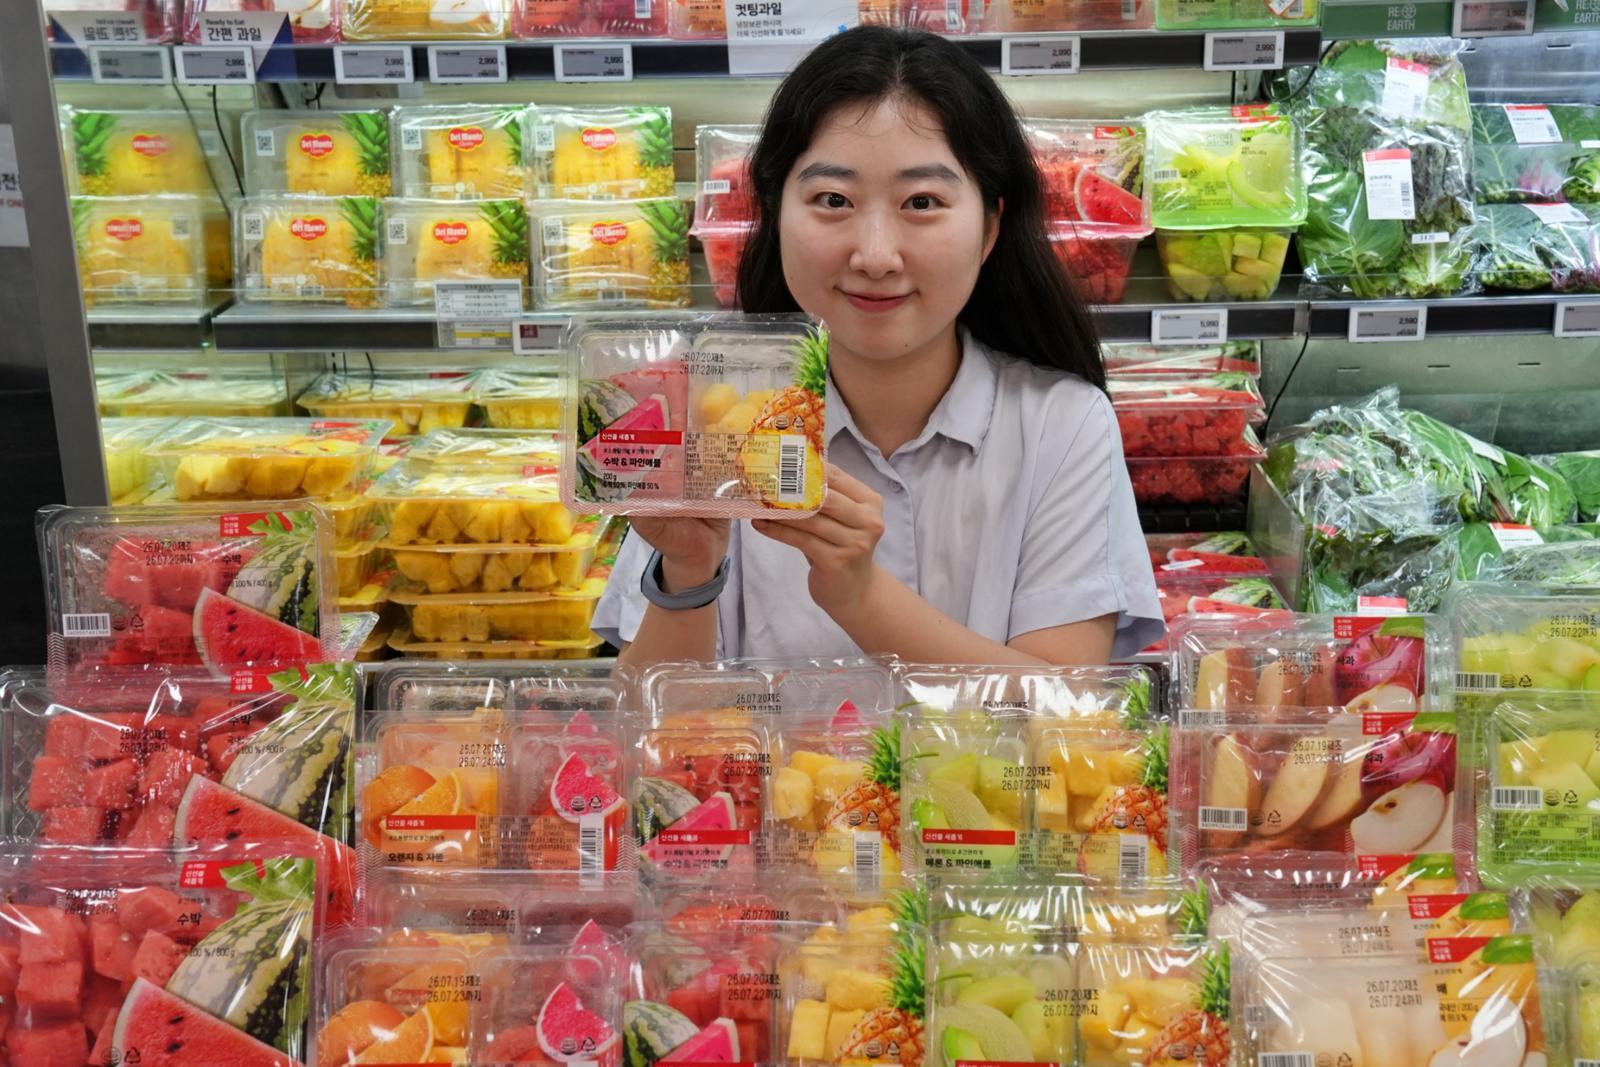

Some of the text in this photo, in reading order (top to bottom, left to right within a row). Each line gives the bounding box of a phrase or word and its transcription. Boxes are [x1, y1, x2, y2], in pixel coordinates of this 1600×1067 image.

[736, 3, 782, 16] 컷팅과일
[1387, 20, 1415, 30] EARTH
[208, 27, 262, 42] 간편 과일
[680, 352, 724, 362] 26.07.20제조
[680, 364, 724, 376] 26.07.22까지
[604, 457, 662, 468] 수박 & 파인애플
[222, 554, 242, 564] 수박
[1550, 627, 1597, 638] 26.07.22까지
[1337, 656, 1354, 665] 사과
[724, 754, 772, 764] 26.07.20제조
[724, 766, 772, 776] 26.07.22까지
[1004, 766, 1052, 778] 26.07.20제조
[1002, 780, 1050, 790] 26.07.22까지
[388, 852, 414, 862] 오렌지
[416, 853, 424, 862] &
[926, 858, 992, 870] 메론 & 파인애플
[177, 912, 202, 926] 수박
[740, 910, 791, 920] 26.07.20제조
[428, 976, 481, 988] 26.07.19제조
[728, 974, 780, 986] 26.07.20제조
[1366, 980, 1418, 993] 26.07.20제조
[1436, 983, 1448, 994] 배
[428, 990, 482, 1002] 26.07.23까지
[728, 989, 782, 1001] 26.07.22까지
[1045, 989, 1098, 1002] 26.07.20제조
[1369, 995, 1422, 1008] 26.07.24까지
[1044, 1005, 1098, 1017] 26.07.22까지
